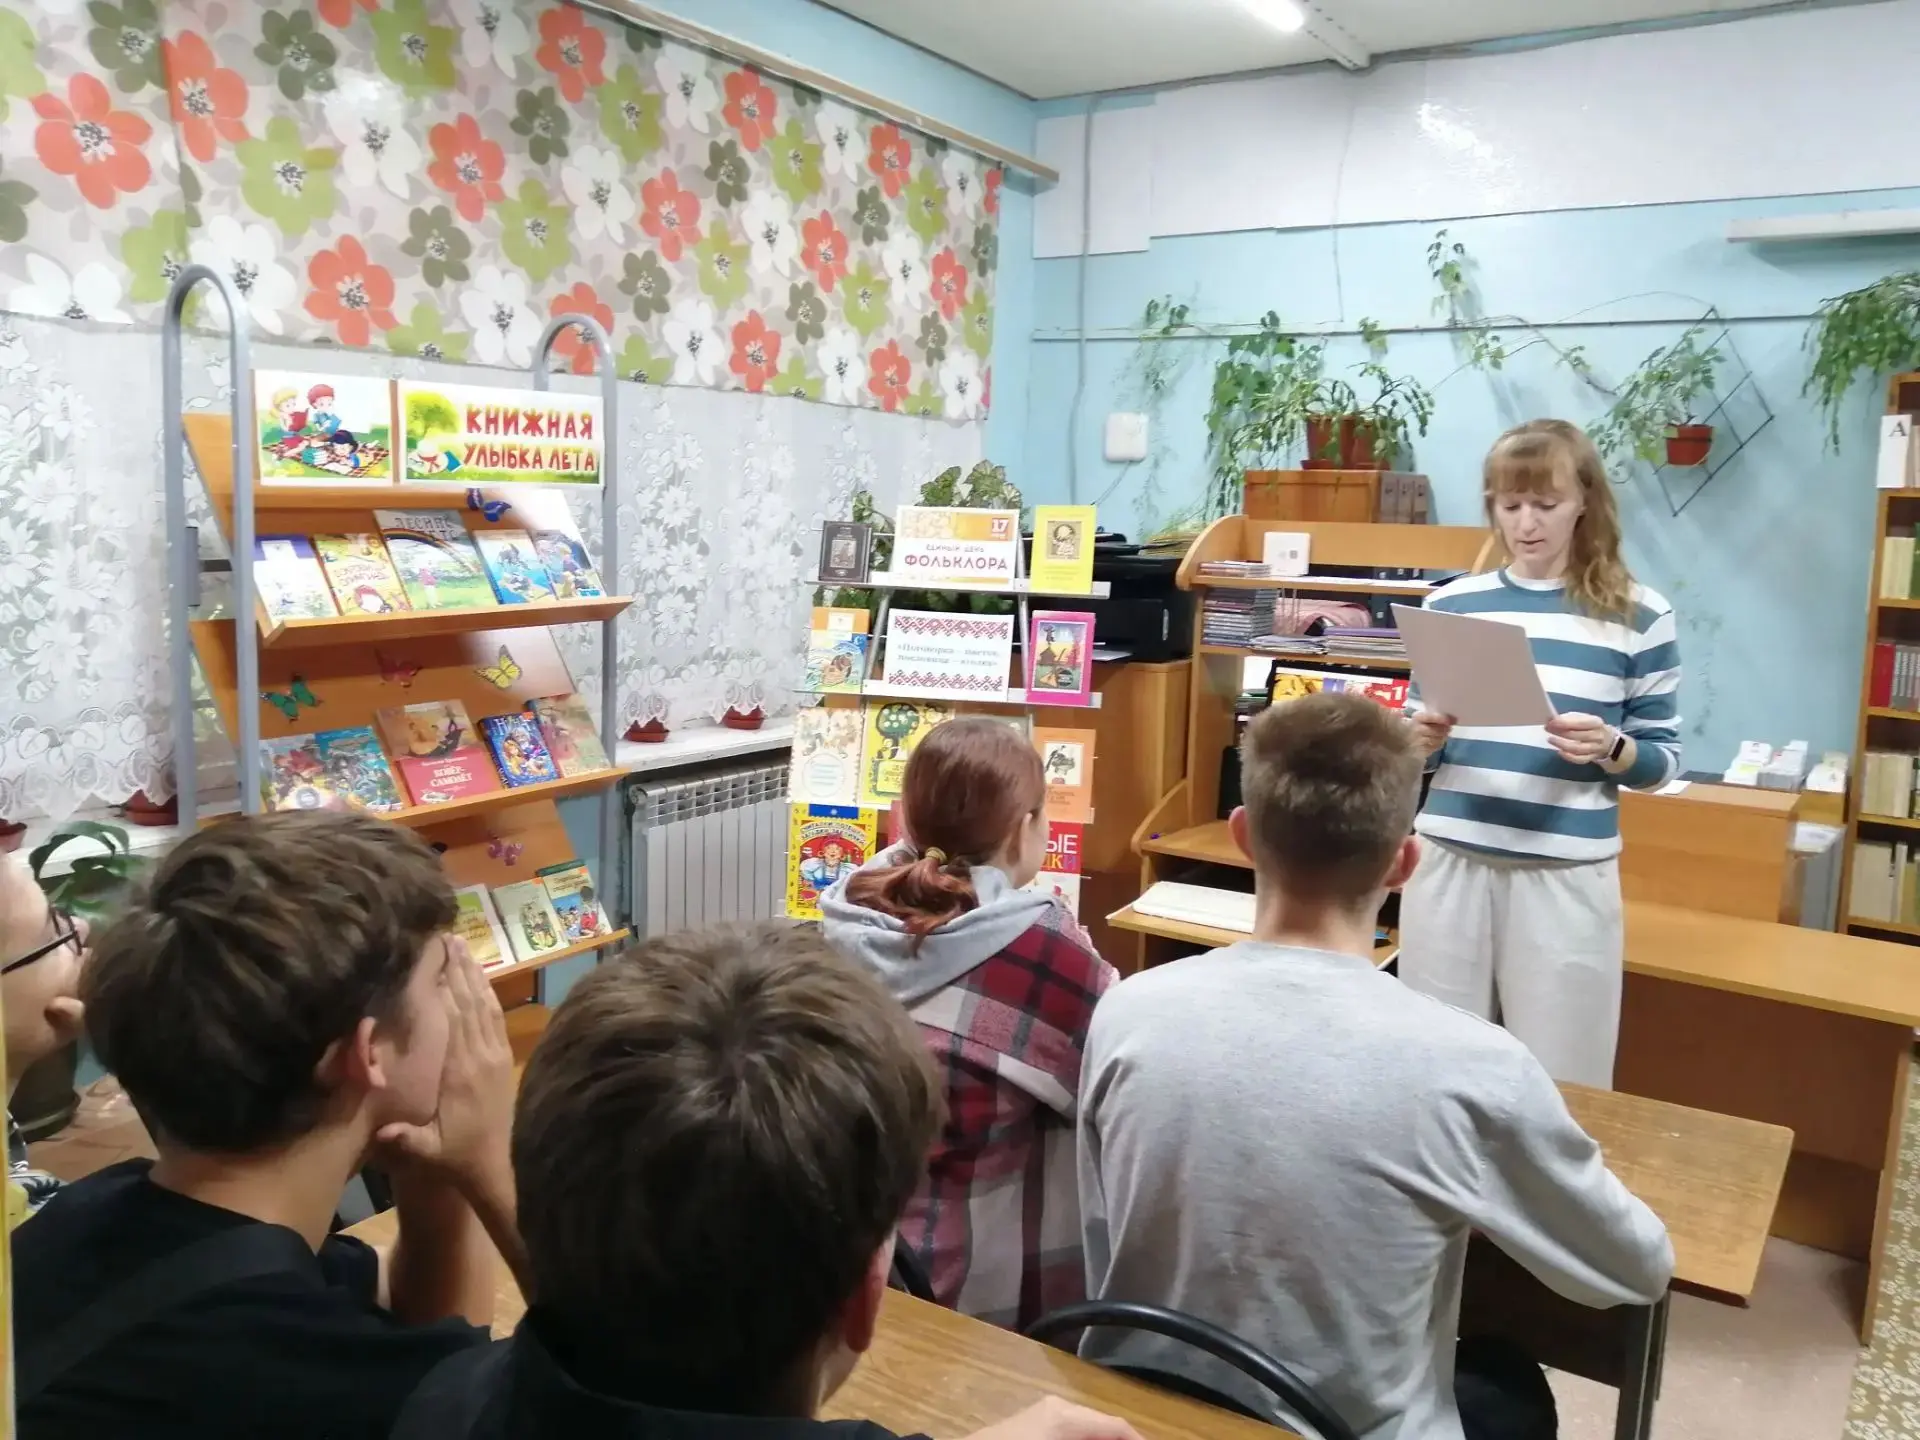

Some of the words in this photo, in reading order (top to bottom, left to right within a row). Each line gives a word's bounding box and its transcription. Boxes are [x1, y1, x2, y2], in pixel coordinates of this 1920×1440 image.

[466, 403, 593, 440] КНИЖНАЯ
[463, 442, 543, 469] УЛЫБКА
[549, 446, 594, 471] ЛЕТА
[992, 518, 1009, 534] 17
[904, 554, 1008, 570] ФОЛЬКЛОРА
[1045, 833, 1078, 855] ЫЕ
